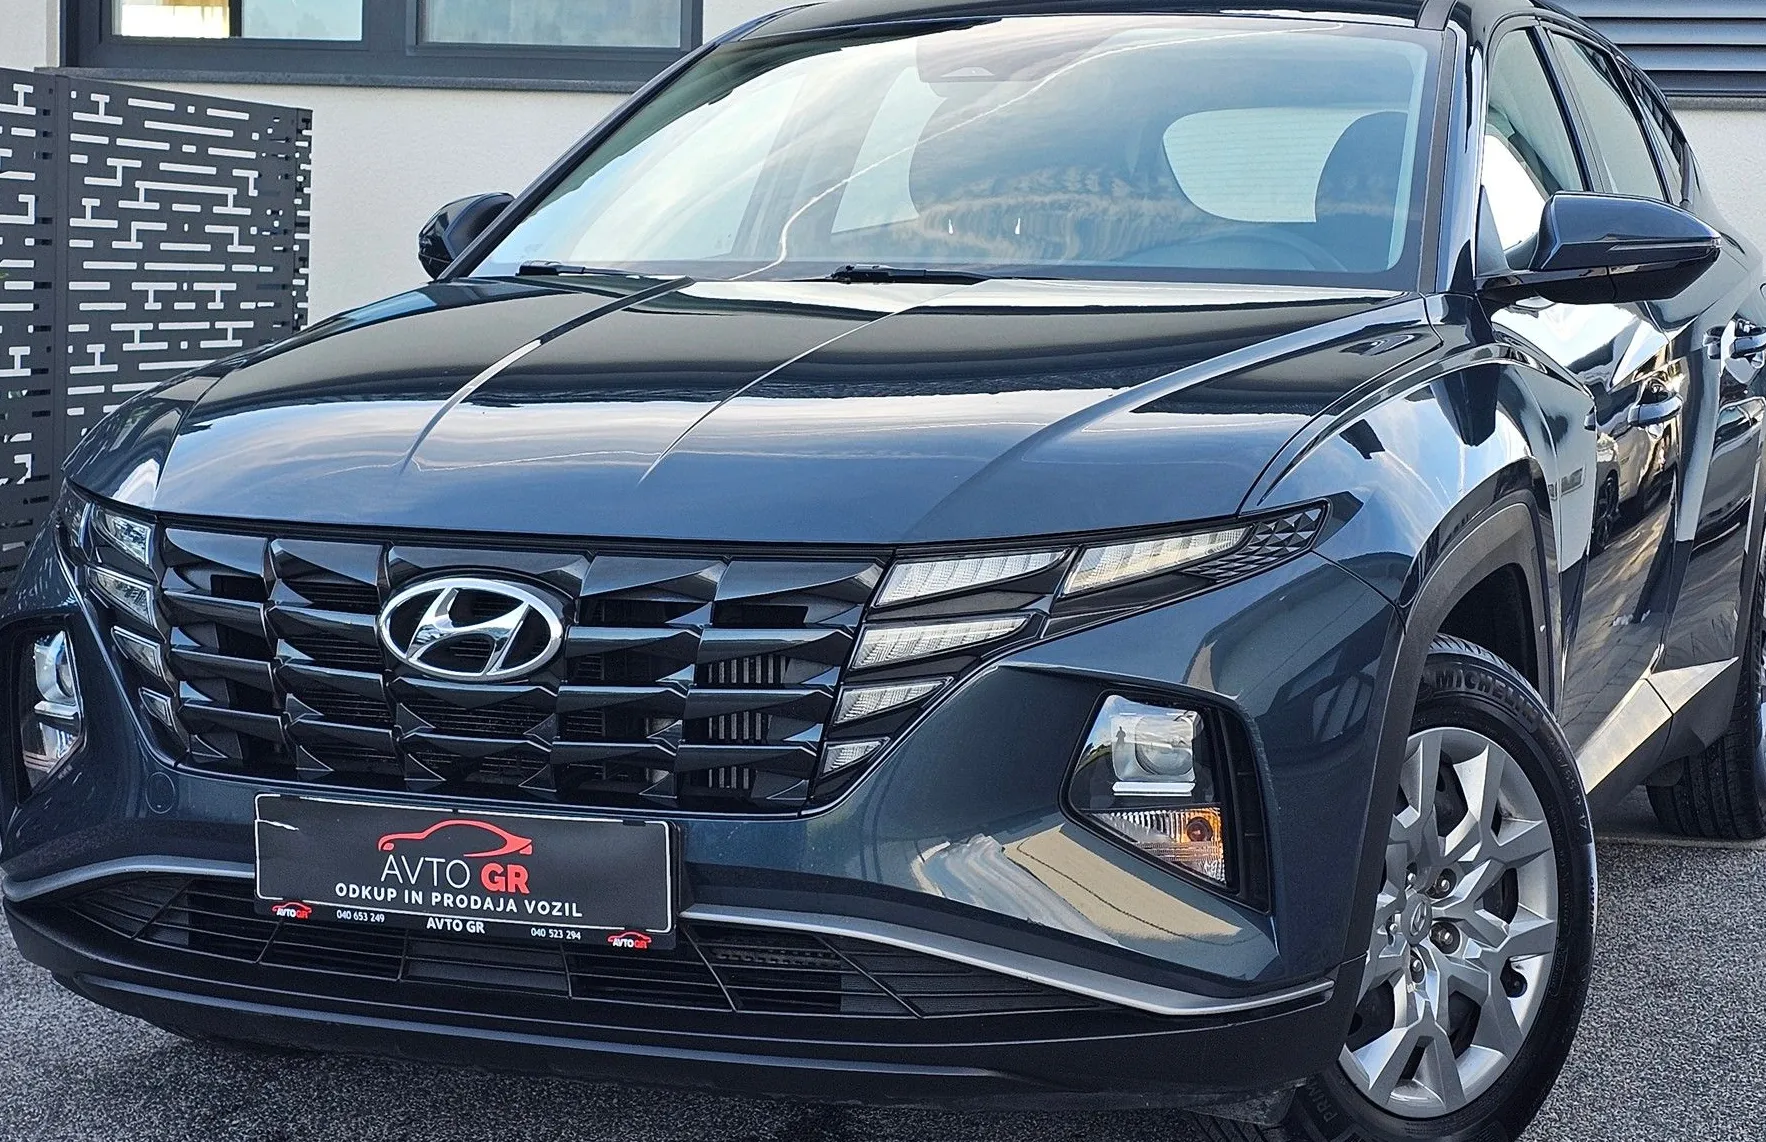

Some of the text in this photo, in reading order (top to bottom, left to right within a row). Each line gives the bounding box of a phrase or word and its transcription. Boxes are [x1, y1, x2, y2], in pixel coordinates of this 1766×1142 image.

[1435, 668, 1539, 722] MICHELIN
[380, 854, 530, 894] AVTO GR
[335, 882, 583, 917] ODKUP IN PRODAJA VOZIL
[336, 909, 386, 923] 040 653 249
[426, 917, 486, 934] AVTO GR
[530, 927, 582, 940] 040 523 294
